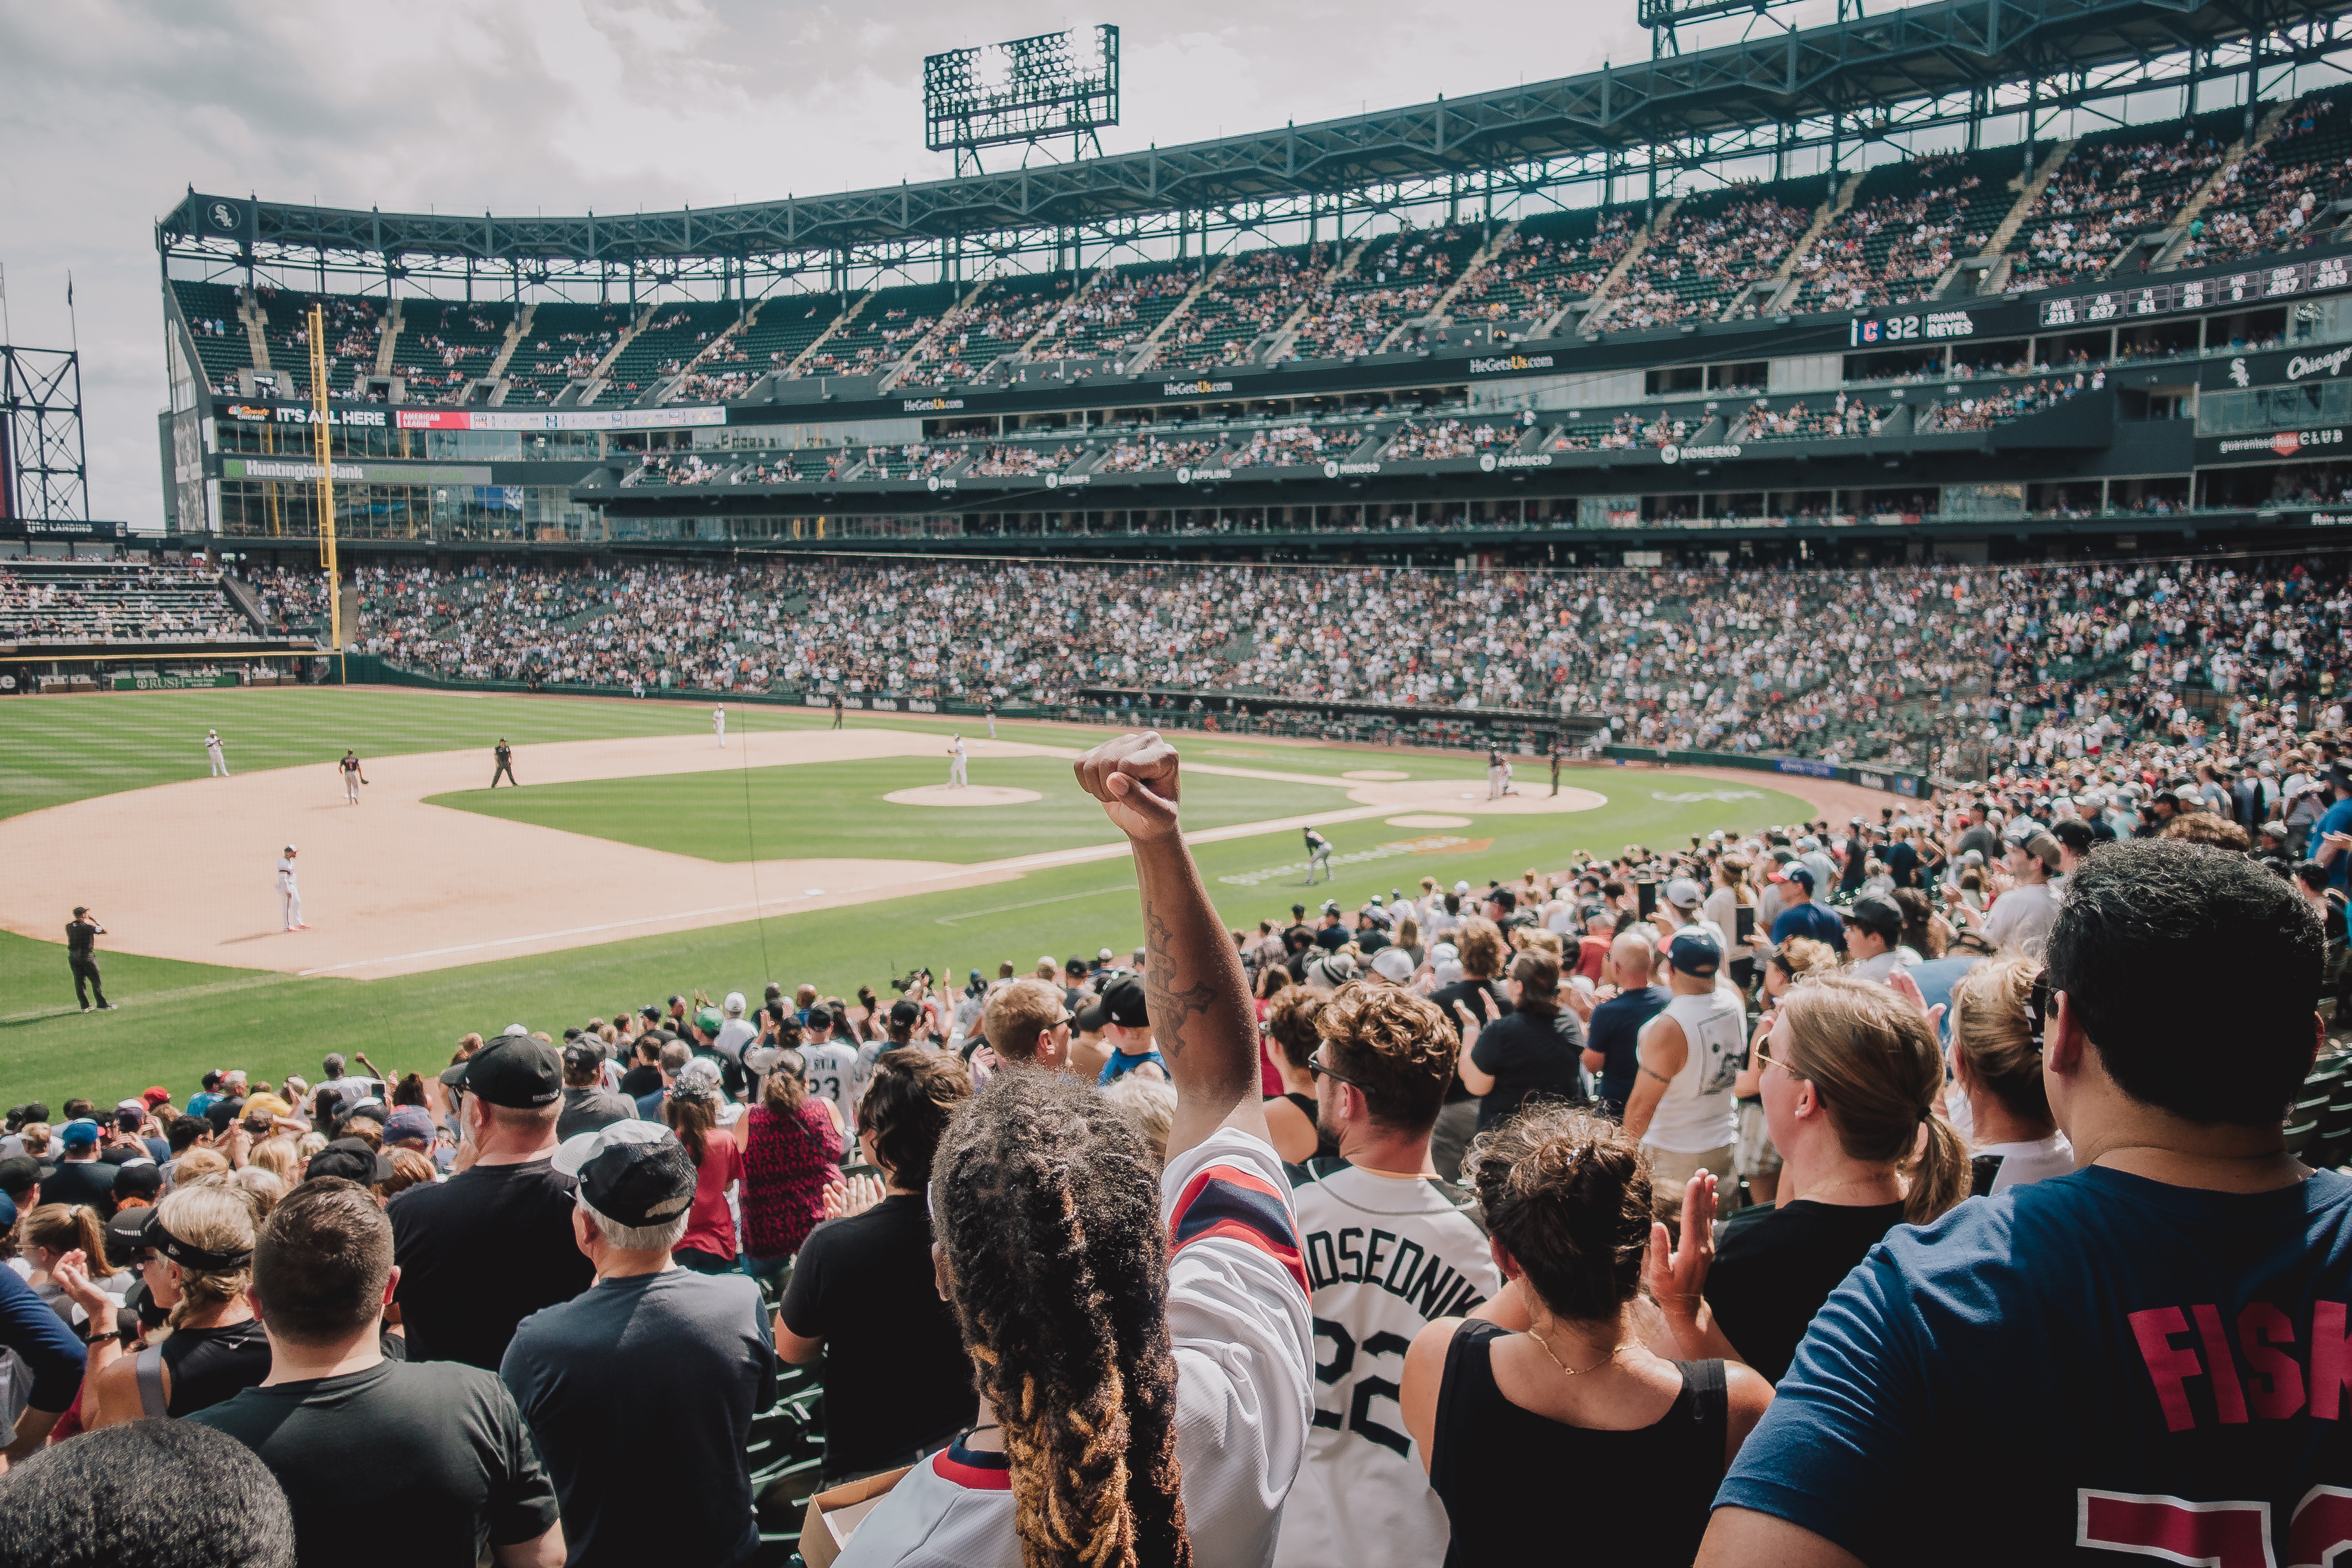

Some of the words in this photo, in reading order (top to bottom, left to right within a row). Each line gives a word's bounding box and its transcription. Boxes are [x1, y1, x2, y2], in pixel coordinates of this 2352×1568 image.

[2230, 275, 2246, 287] HR
[2049, 299, 2072, 311] AVG
[2089, 303, 2117, 320] 237
[2137, 299, 2156, 313] 51
[2045, 308, 2075, 325] .215
[1886, 315, 1919, 340] 32
[1927, 321, 1973, 338] REYES
[1470, 355, 1553, 373] HeGetsUs.com
[1164, 380, 1233, 395] HeGetsUs.com
[904, 397, 964, 411] HeGetsUs.com
[277, 408, 306, 423] IT'S
[308, 409, 340, 424] ALL
[343, 411, 387, 426] HERE
[403, 412, 441, 422] AMERICAN
[2299, 429, 2343, 445] CLUB
[1680, 444, 1741, 460] KONERKO
[1497, 454, 1552, 467] APARICIO
[330, 463, 364, 480] Bank
[372, 469, 429, 481] STADIUM
[1191, 469, 1232, 480] APPLING
[940, 479, 957, 488] FOX
[150, 678, 184, 689] RUSH
[1302, 1227, 1488, 1322] DSEDNIK
